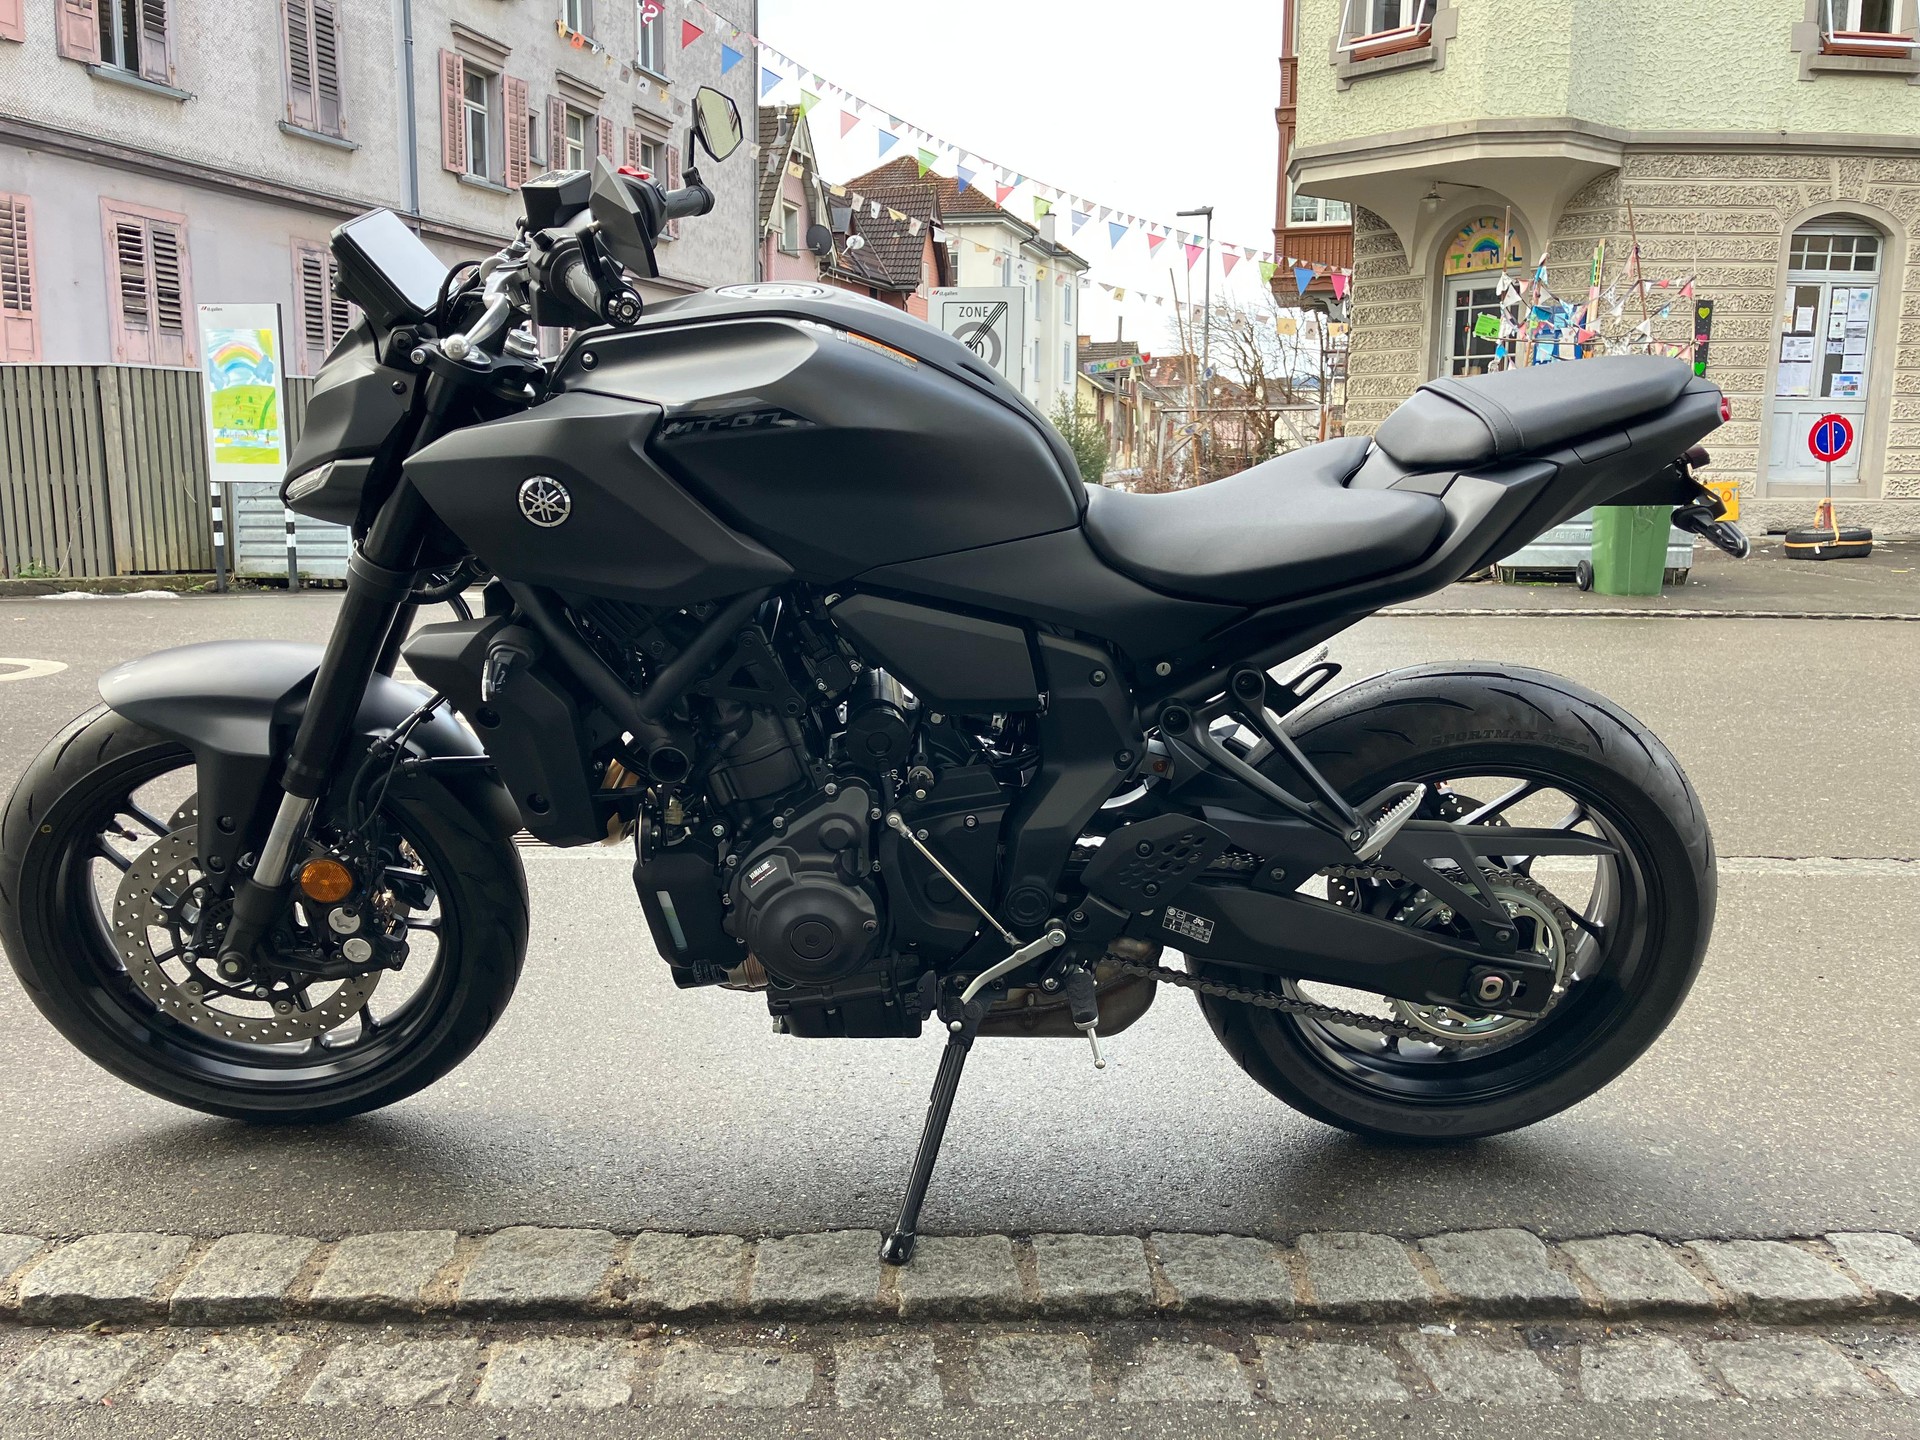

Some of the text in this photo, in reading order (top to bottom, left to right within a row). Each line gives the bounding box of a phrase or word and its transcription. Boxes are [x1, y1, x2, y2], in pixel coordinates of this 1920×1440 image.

[959, 306, 988, 317] ZONE
[664, 412, 782, 435] MT-07
[1430, 729, 1538, 746] SPORTMAX
